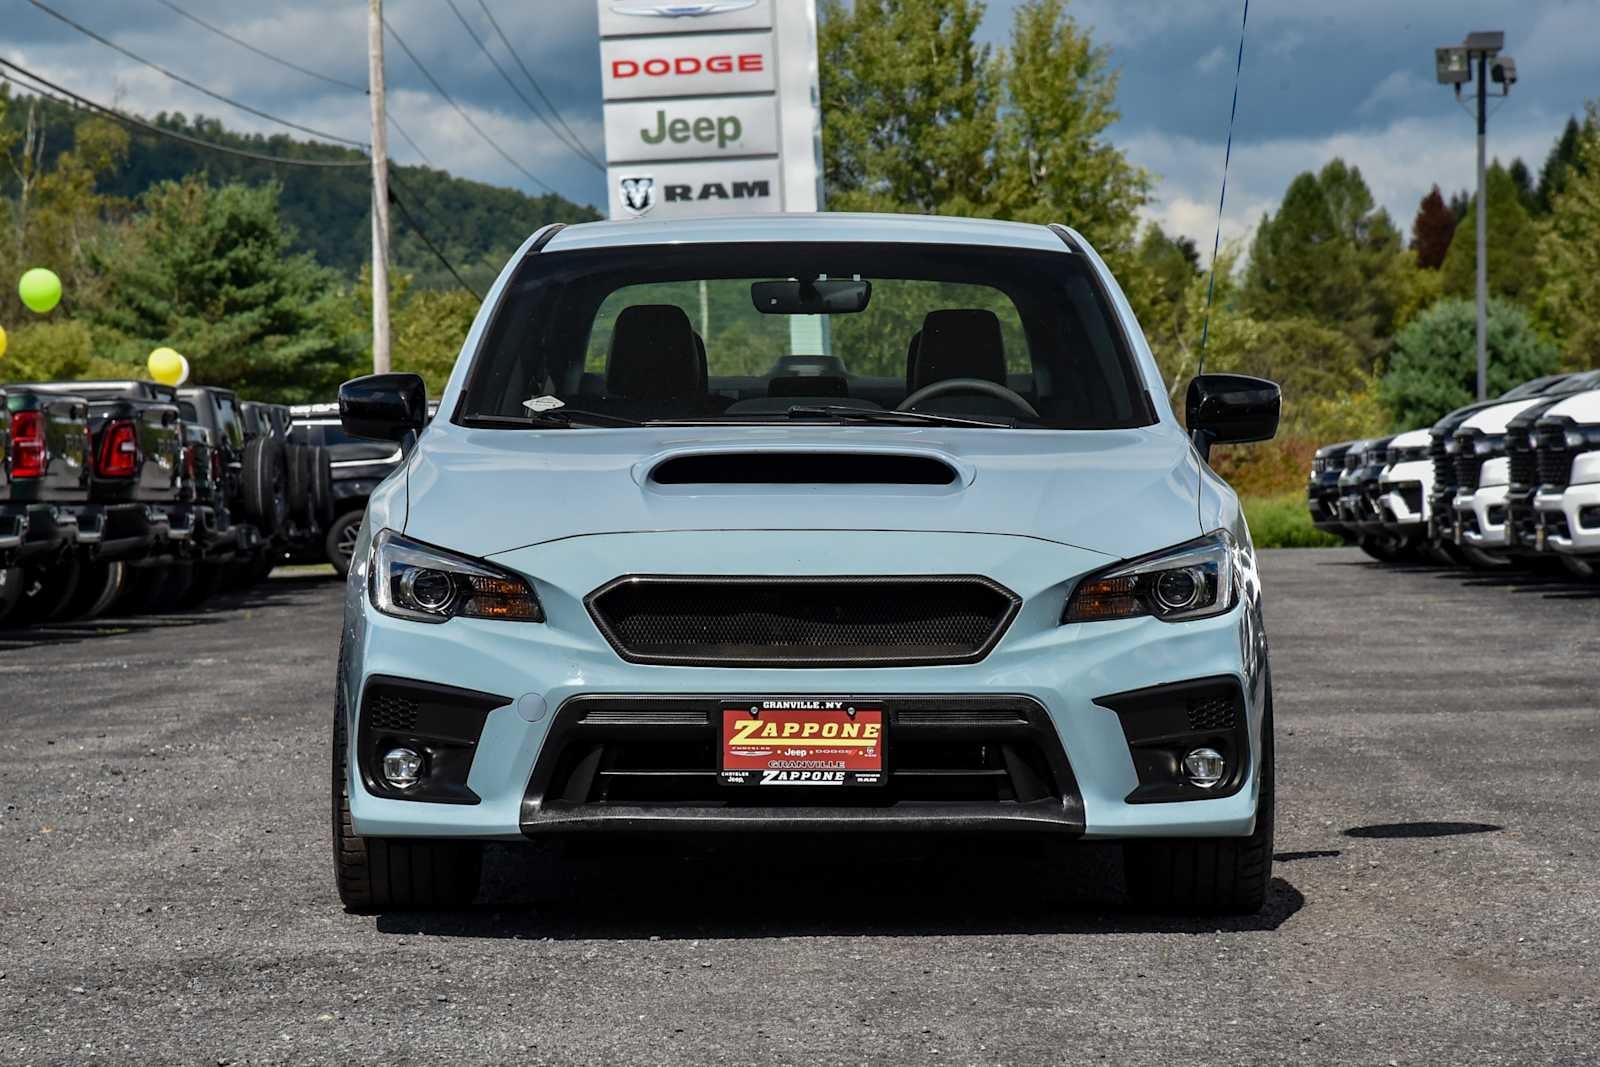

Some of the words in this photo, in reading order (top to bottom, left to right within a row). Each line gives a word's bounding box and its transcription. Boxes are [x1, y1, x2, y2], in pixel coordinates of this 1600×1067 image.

[612, 54, 764, 79] DODGE
[640, 110, 742, 149] Jeep
[664, 180, 770, 203] RAM
[729, 720, 881, 745] ZAPPONE
[784, 748, 807, 757] Jeep
[768, 760, 846, 769] GRANVILLE
[760, 770, 846, 785] ZAPPONE
